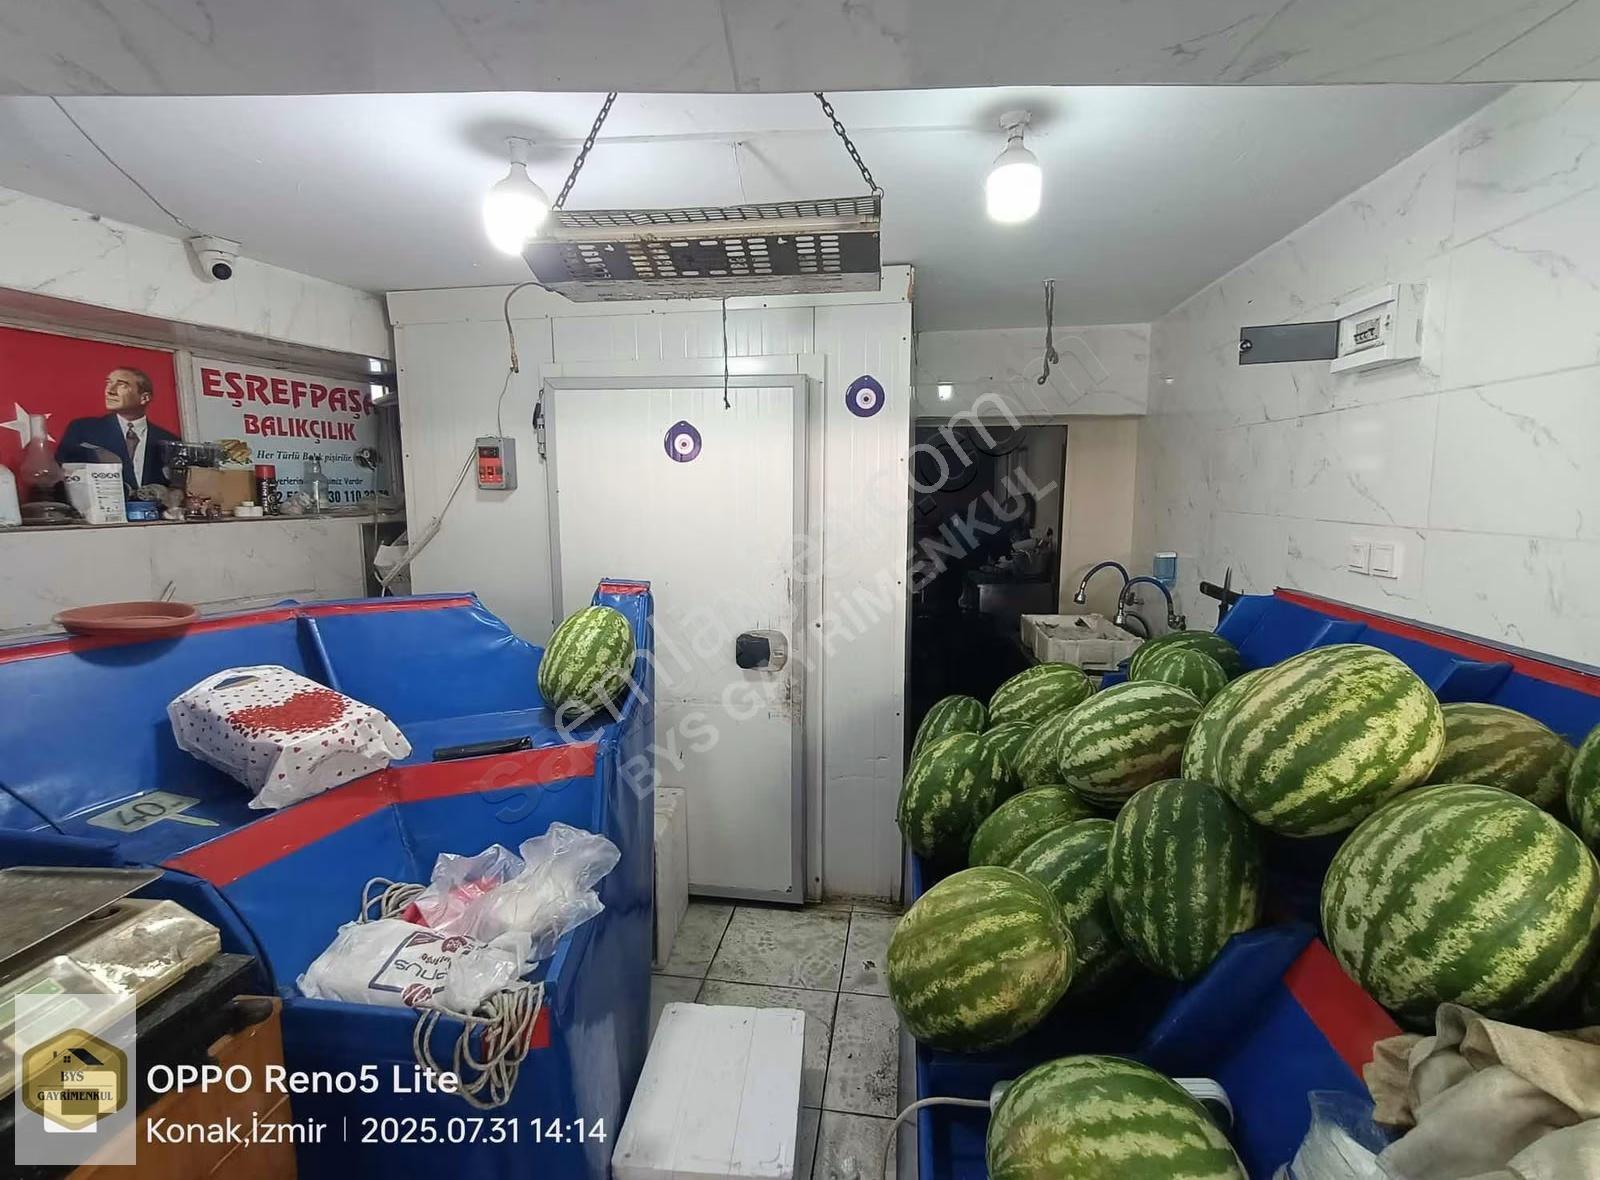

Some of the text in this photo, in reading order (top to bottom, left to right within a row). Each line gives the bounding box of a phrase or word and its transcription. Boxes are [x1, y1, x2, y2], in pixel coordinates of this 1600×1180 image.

[243, 413, 358, 445] BALIKÇILIK
[256, 450, 275, 460] Her
[276, 450, 300, 461] Türlü
